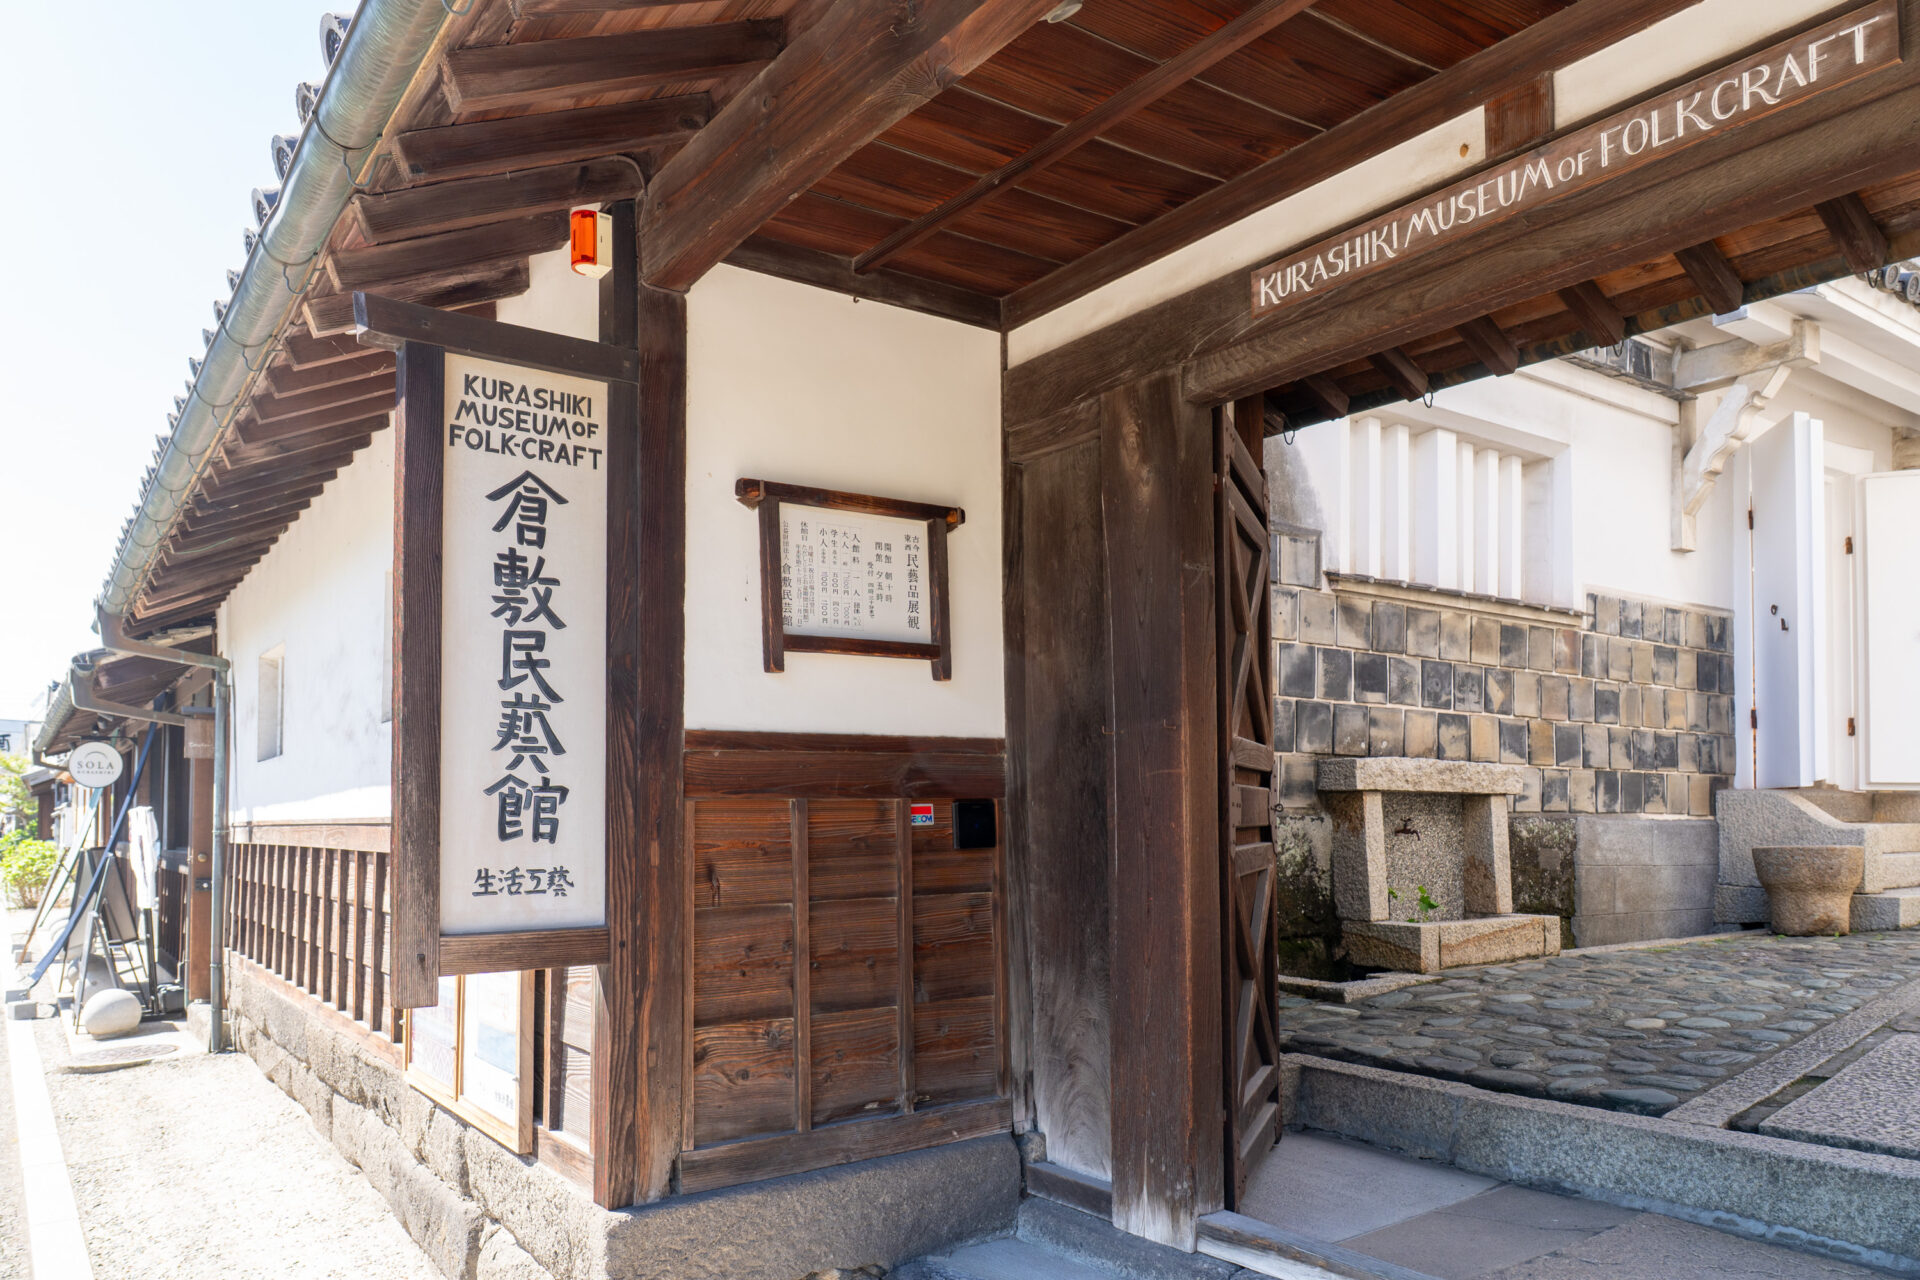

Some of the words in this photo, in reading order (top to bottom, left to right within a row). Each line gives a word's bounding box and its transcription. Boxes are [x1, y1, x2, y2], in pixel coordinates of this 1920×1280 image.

[1257, 223, 1399, 307] KURASHIKI
[1403, 156, 1555, 249] MUSEUM
[1557, 148, 1593, 183] OF
[1599, 15, 1881, 169] FOLKCRAFT
[464, 373, 593, 419] KURASHIKI
[454, 399, 572, 440] MUSEUM
[572, 419, 599, 439] OF
[448, 424, 603, 471] FOLK-CRAFT
[819, 527, 828, 548] 小人
[830, 528, 839, 548] 学生
[841, 530, 850, 550] 大人
[851, 533, 861, 564] 入館料
[906, 553, 921, 630] 民藝品展観
[483, 470, 569, 845] 倉敷民藝館
[76, 760, 115, 770] SOLA
[911, 814, 933, 823] ECOM
[471, 865, 575, 898] 生活工藝
